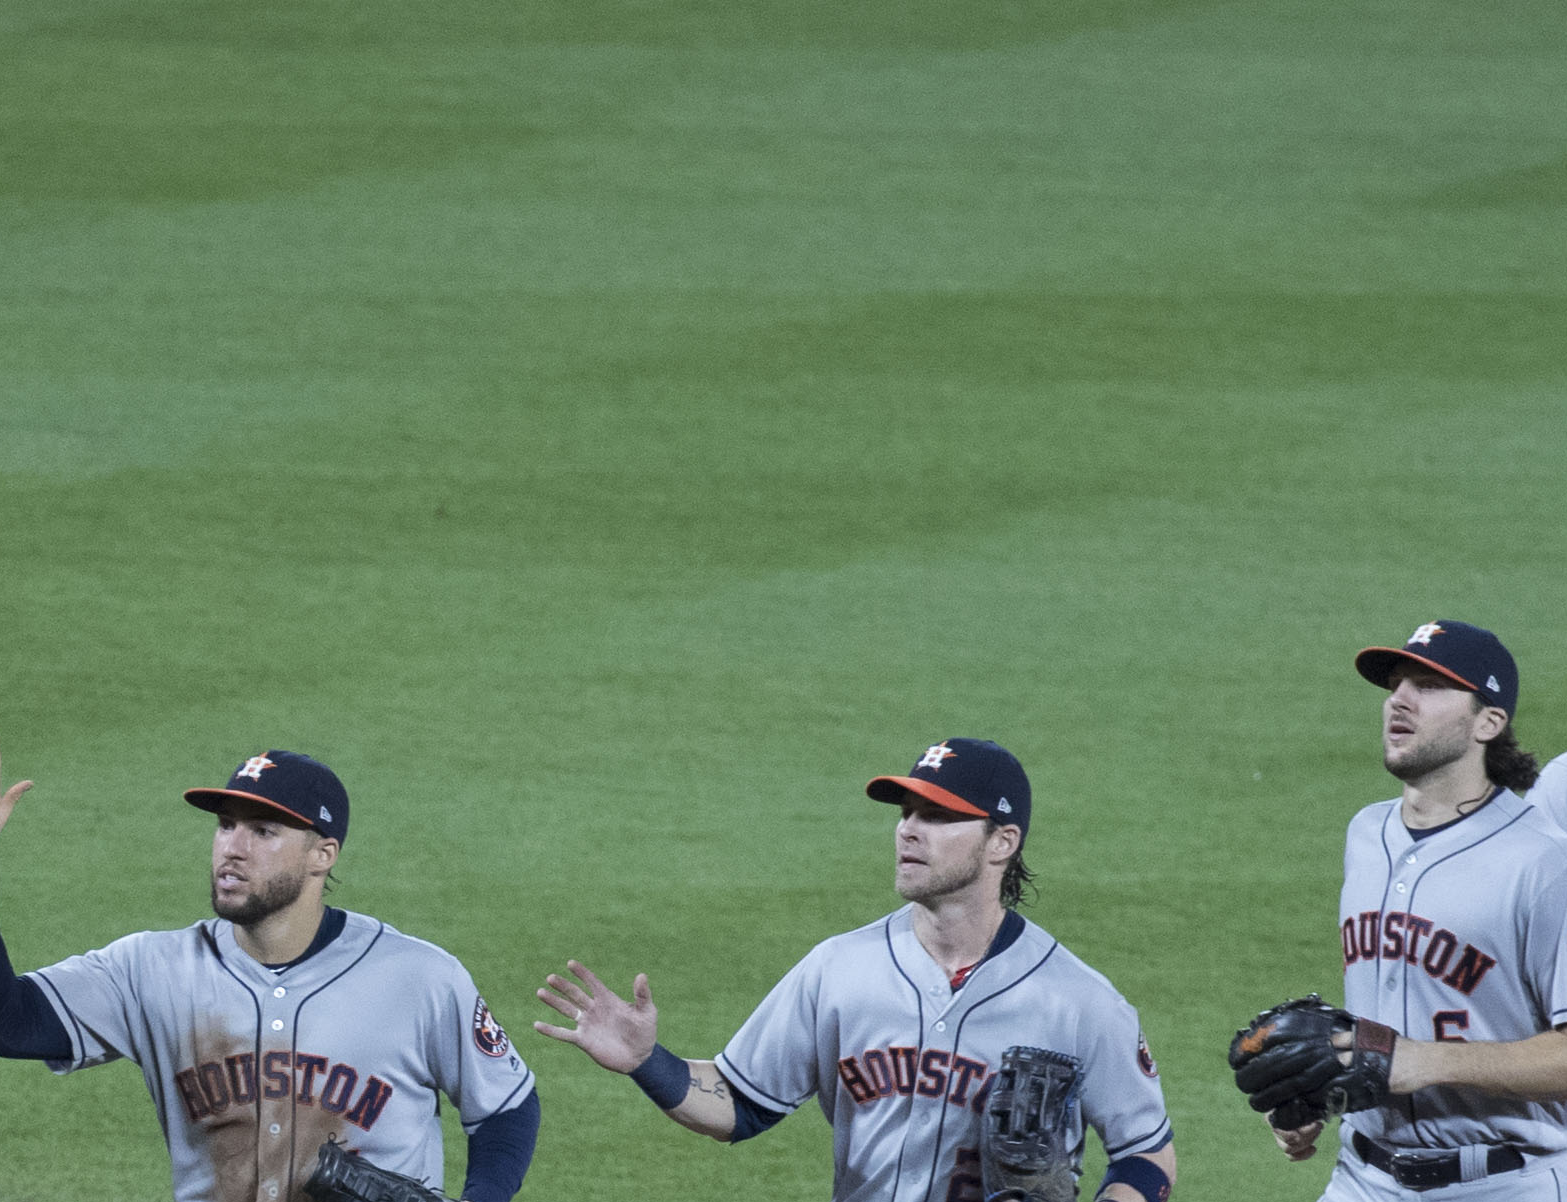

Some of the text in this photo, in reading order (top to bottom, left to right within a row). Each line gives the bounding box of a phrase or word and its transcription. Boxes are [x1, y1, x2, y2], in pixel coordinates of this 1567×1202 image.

[237, 757, 273, 779] H
[917, 746, 953, 769] H
[1341, 911, 1497, 996] OUSTON
[176, 1051, 393, 1132] HOUSTON
